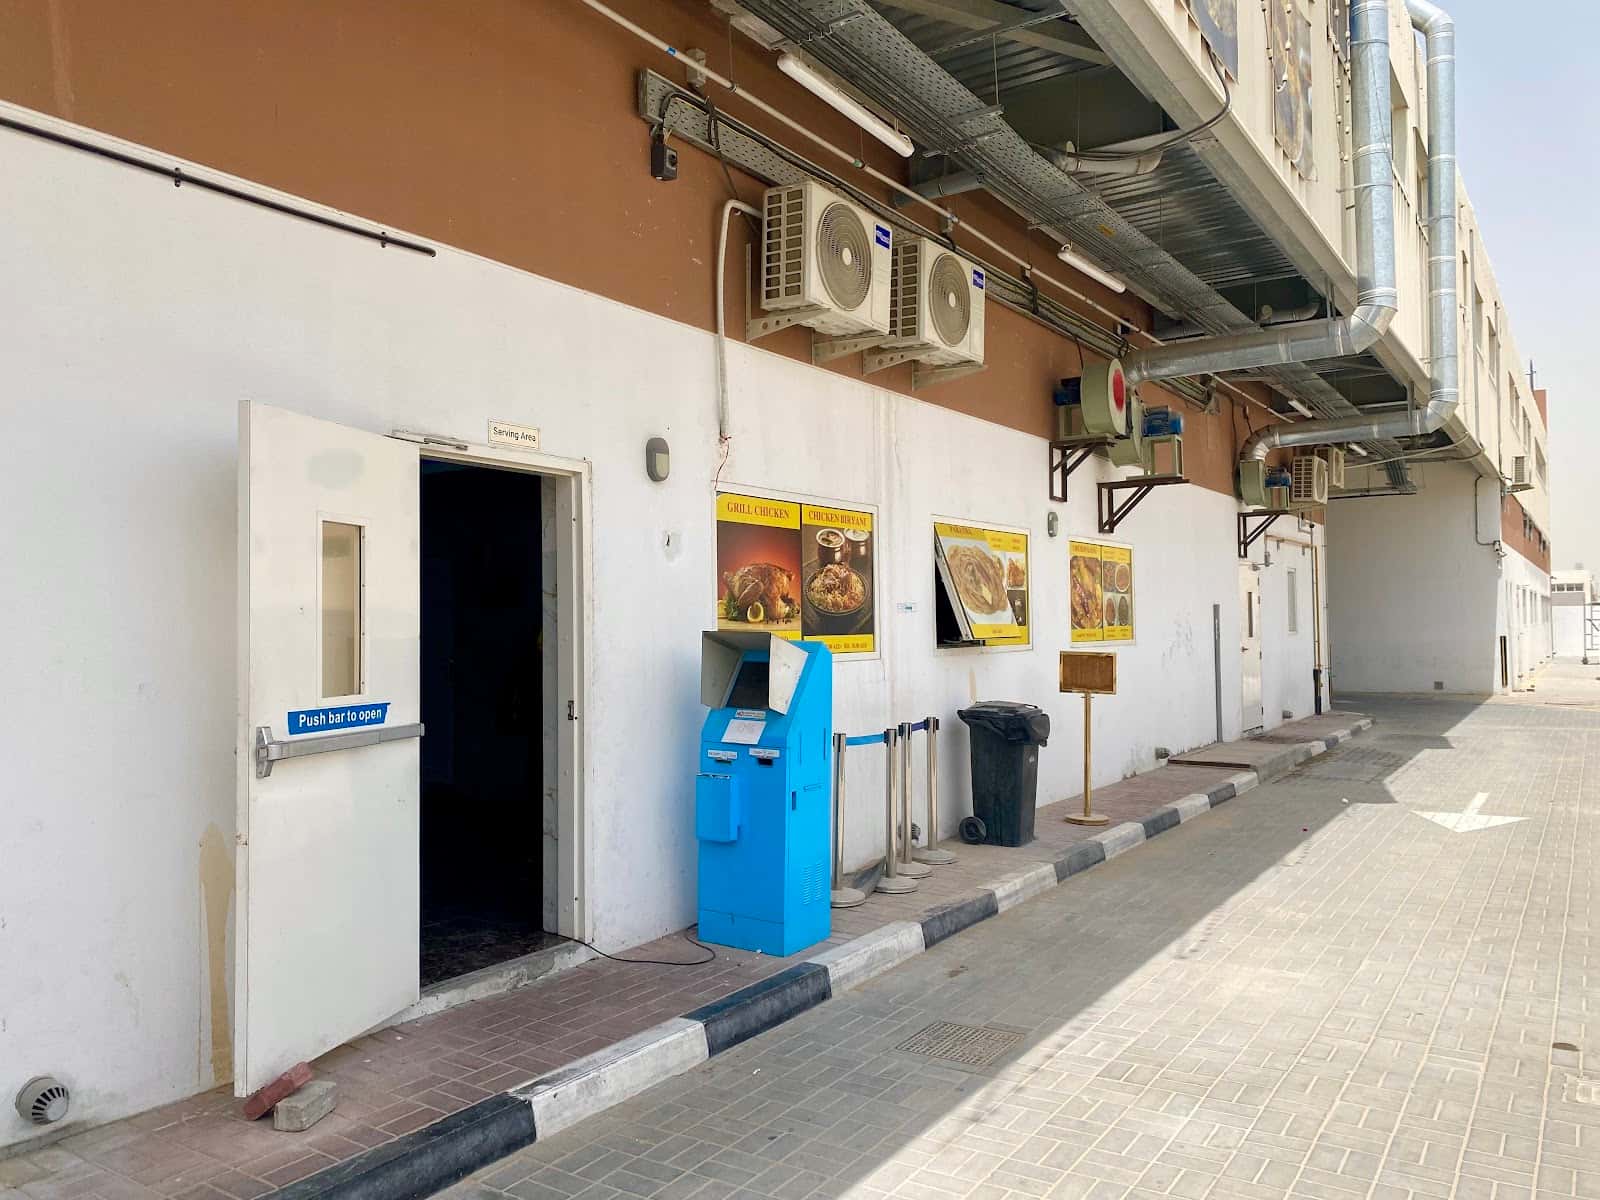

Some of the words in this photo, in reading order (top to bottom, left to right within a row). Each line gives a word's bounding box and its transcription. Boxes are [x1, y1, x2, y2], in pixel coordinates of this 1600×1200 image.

[493, 426, 520, 441] Serving
[520, 432, 536, 442] Area
[727, 502, 752, 514] GRILL
[754, 505, 790, 519] CHICKEN
[808, 511, 840, 522] CHICKEN
[840, 515, 867, 527] BIRYANI
[299, 711, 326, 728] Push
[328, 711, 346, 724] bar
[347, 710, 357, 722] to
[358, 709, 382, 723] open
